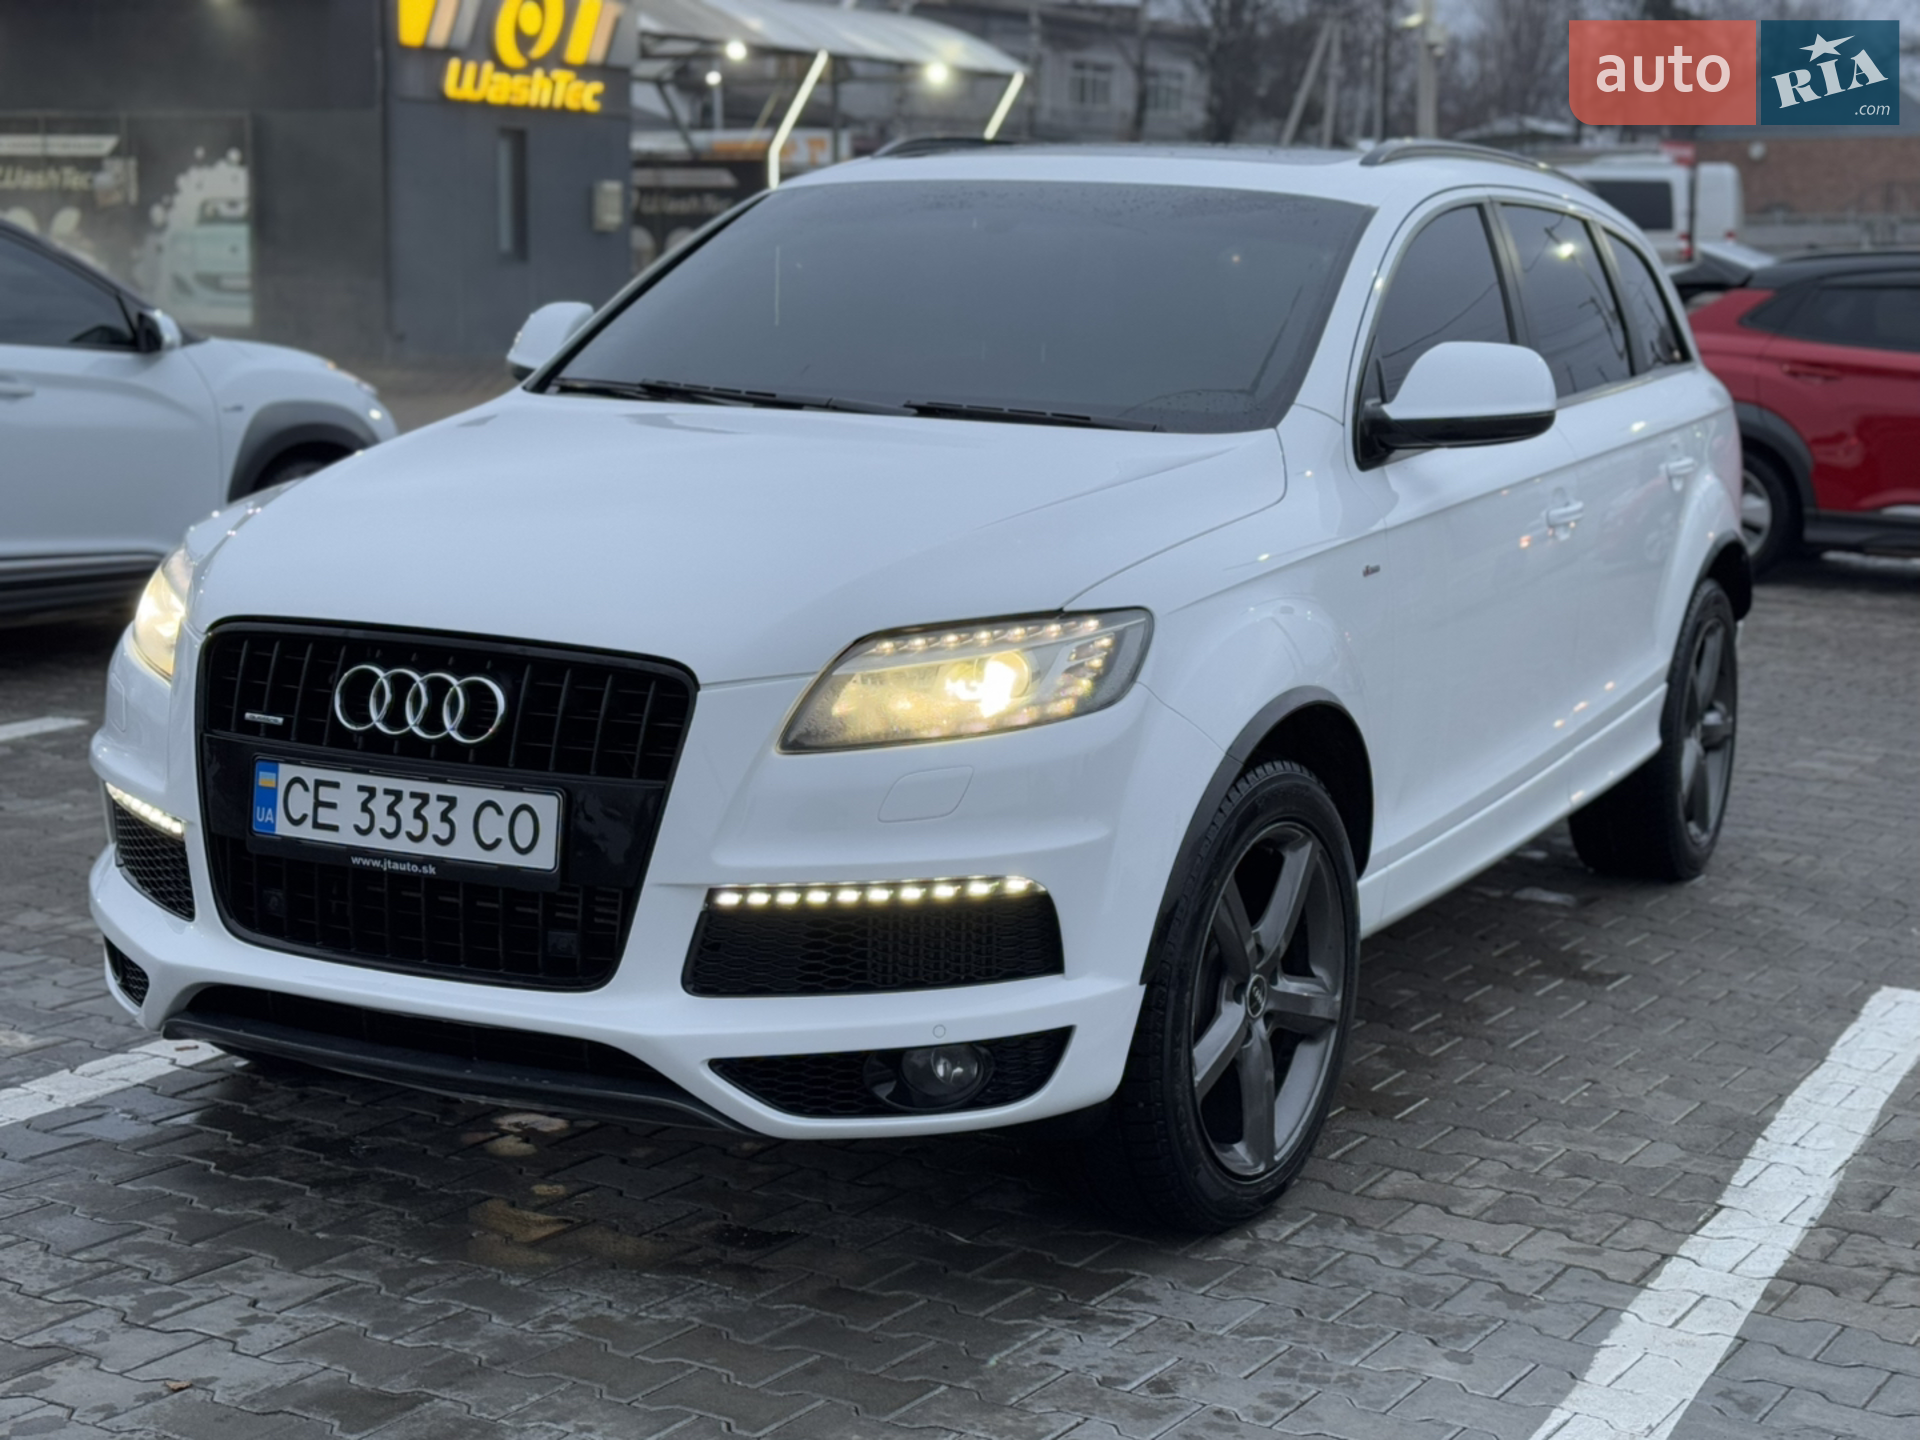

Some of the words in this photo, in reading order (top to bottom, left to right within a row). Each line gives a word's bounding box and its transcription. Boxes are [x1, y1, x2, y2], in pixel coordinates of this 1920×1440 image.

[443, 57, 605, 113] WashTec
[256, 806, 275, 825] UA
[282, 775, 341, 833] CE
[353, 784, 458, 846] 3333
[472, 799, 541, 856] CO
[350, 854, 437, 876] www.jtauto.sk
